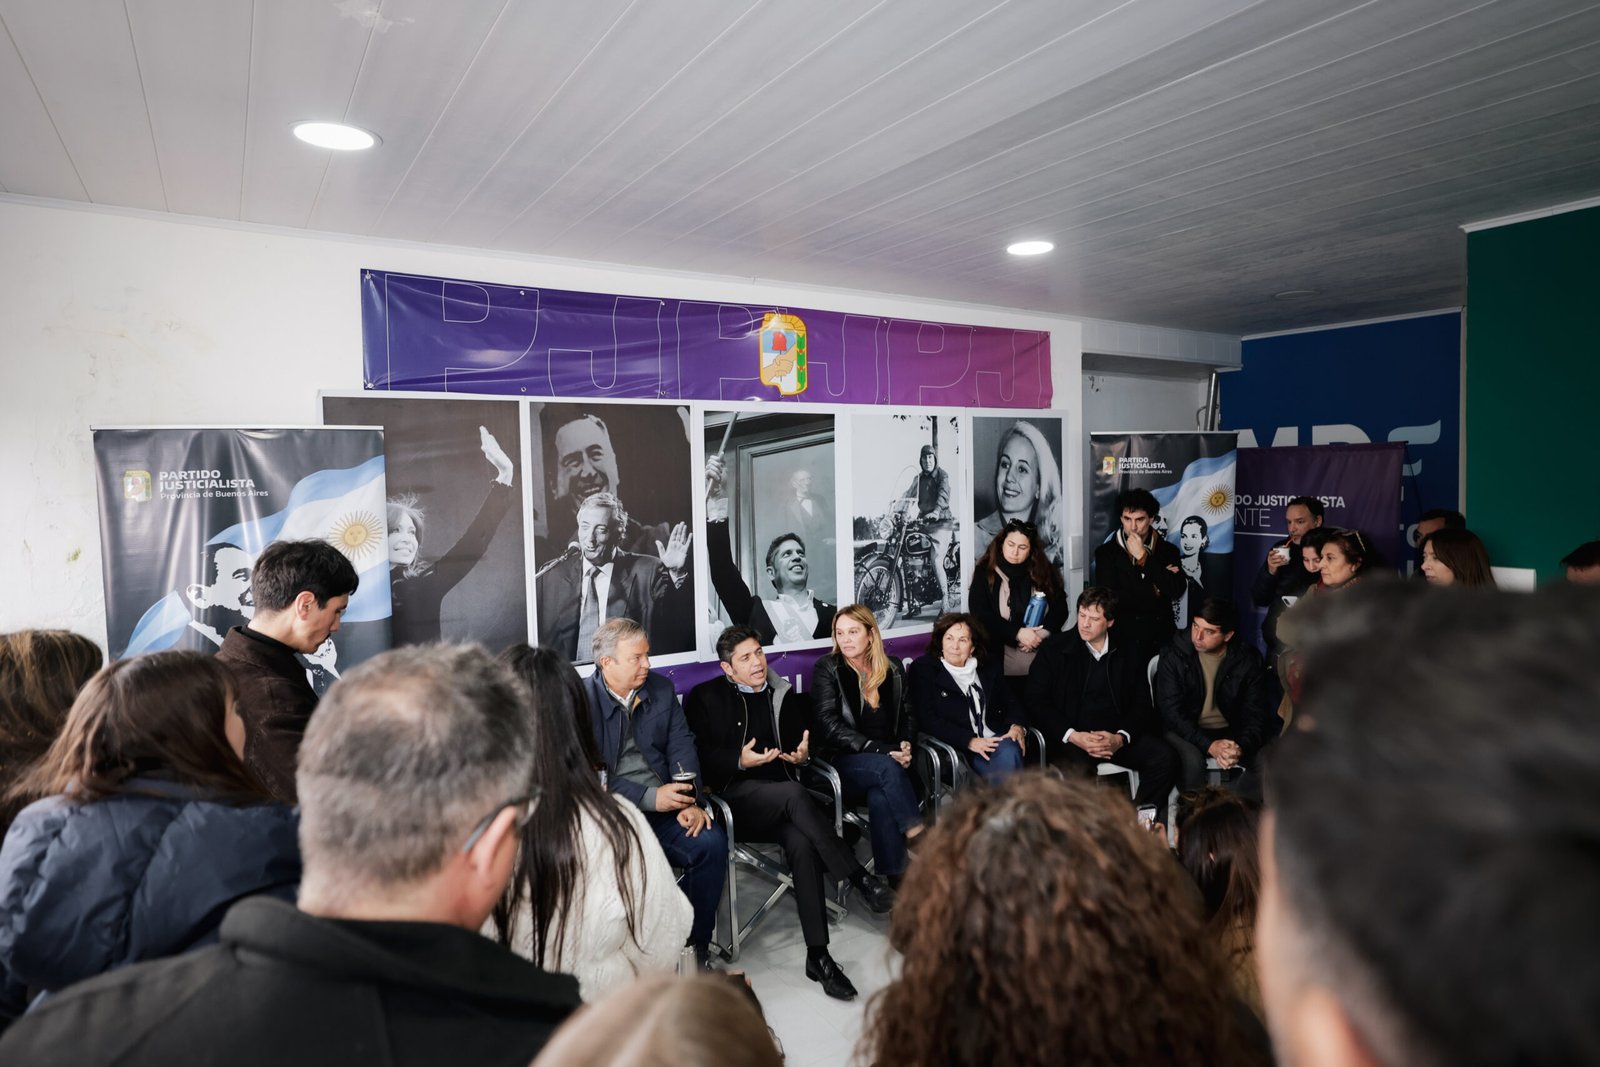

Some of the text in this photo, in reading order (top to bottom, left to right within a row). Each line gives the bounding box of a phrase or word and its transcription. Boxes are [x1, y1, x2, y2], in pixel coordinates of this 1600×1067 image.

[159, 470, 221, 480] PARTIDO
[159, 479, 256, 492] JUSTICIALISTA
[160, 489, 269, 500] Provincia de Buenos Aires
